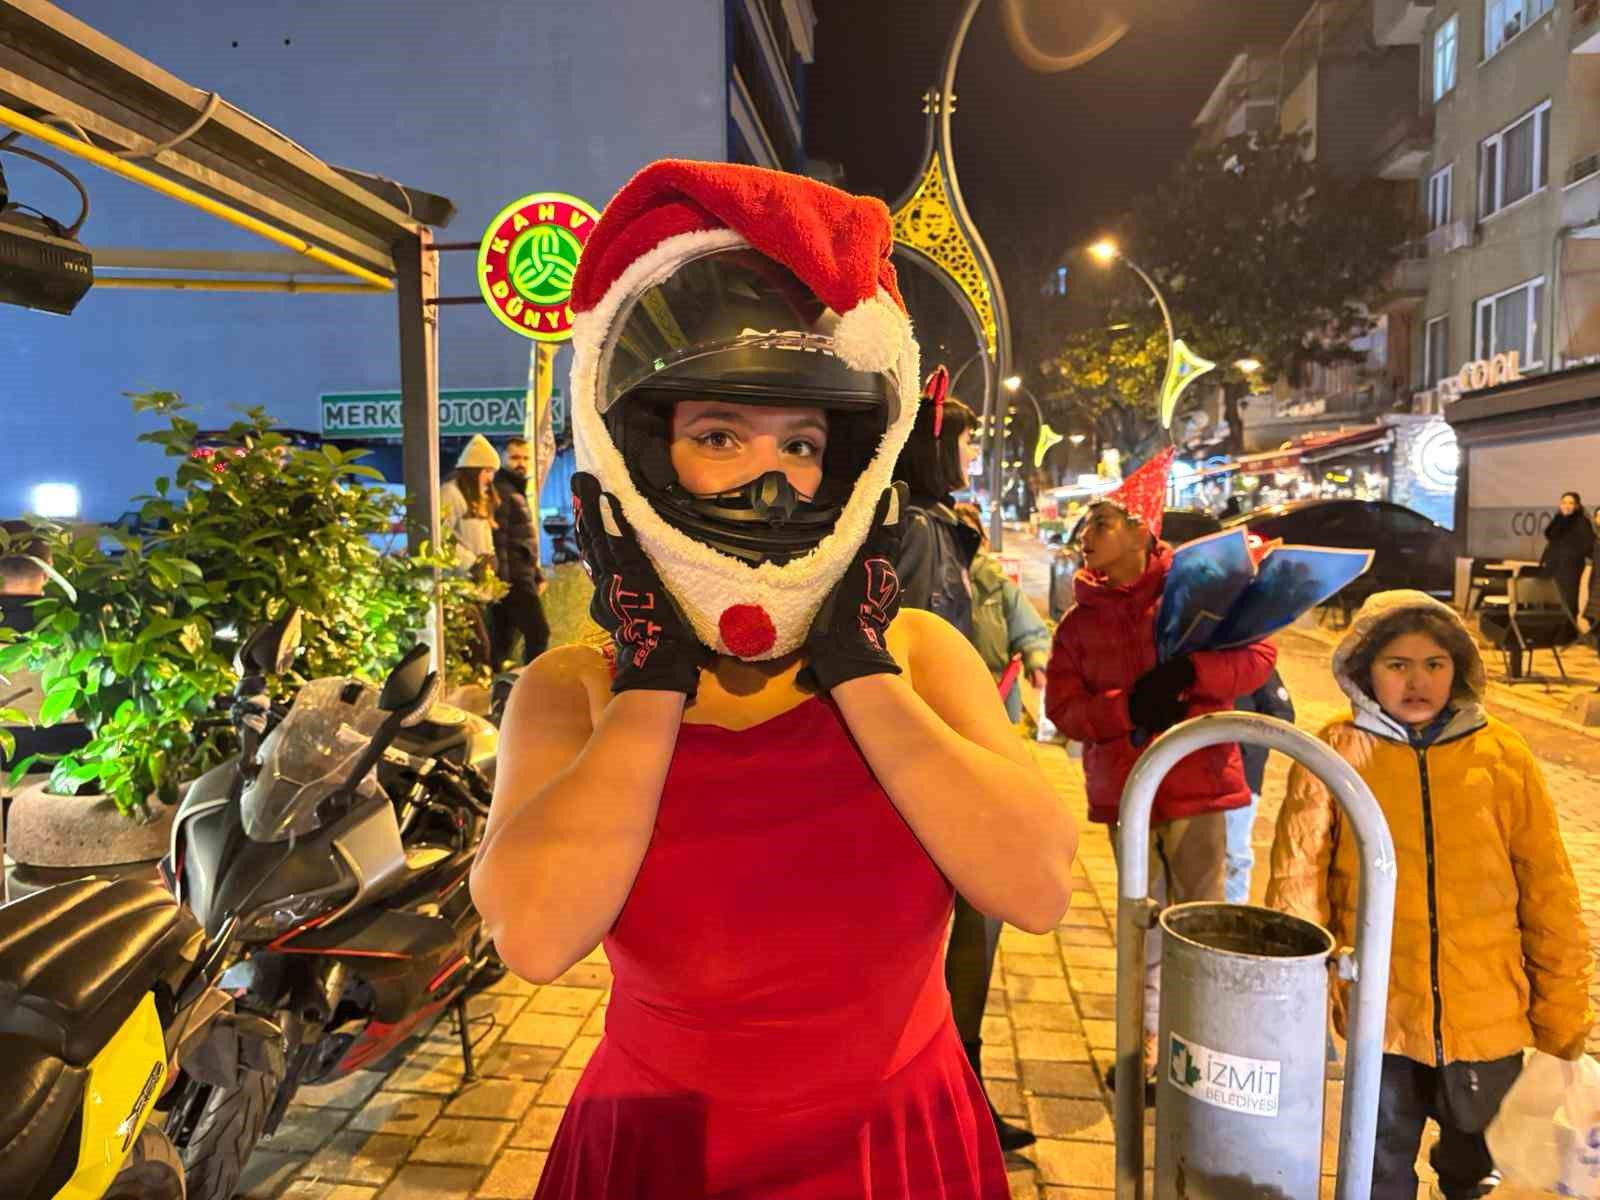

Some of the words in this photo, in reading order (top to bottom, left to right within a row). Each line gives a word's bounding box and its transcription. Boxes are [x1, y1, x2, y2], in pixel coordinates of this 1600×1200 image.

[491, 203, 588, 254] KAHV
[325, 402, 403, 428] MERK
[439, 399, 561, 426] OTOPAK
[1206, 1054, 1277, 1095] İZMİT
